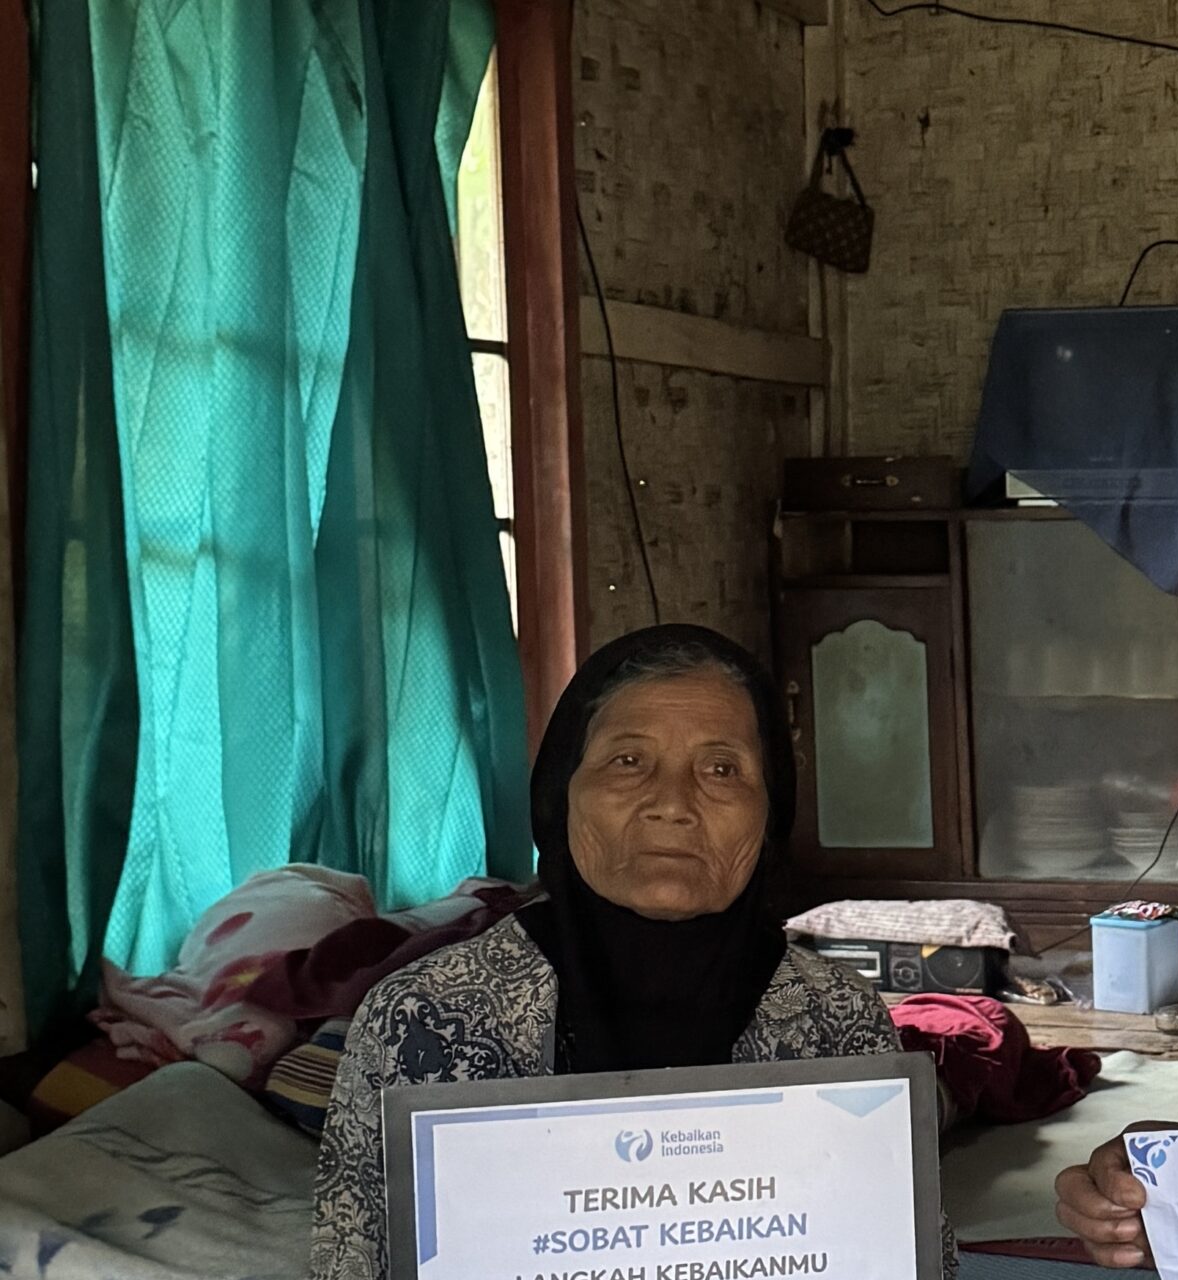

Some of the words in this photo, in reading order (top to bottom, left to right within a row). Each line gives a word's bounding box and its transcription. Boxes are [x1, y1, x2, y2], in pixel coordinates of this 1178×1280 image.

[660, 1128, 721, 1144] Kebaikan
[661, 1141, 725, 1157] Indonesia
[563, 1183, 678, 1214] TERIMA
[688, 1176, 776, 1206] KASIH
[532, 1224, 649, 1255] #SOBAT
[659, 1213, 808, 1247] KEBAIKAN
